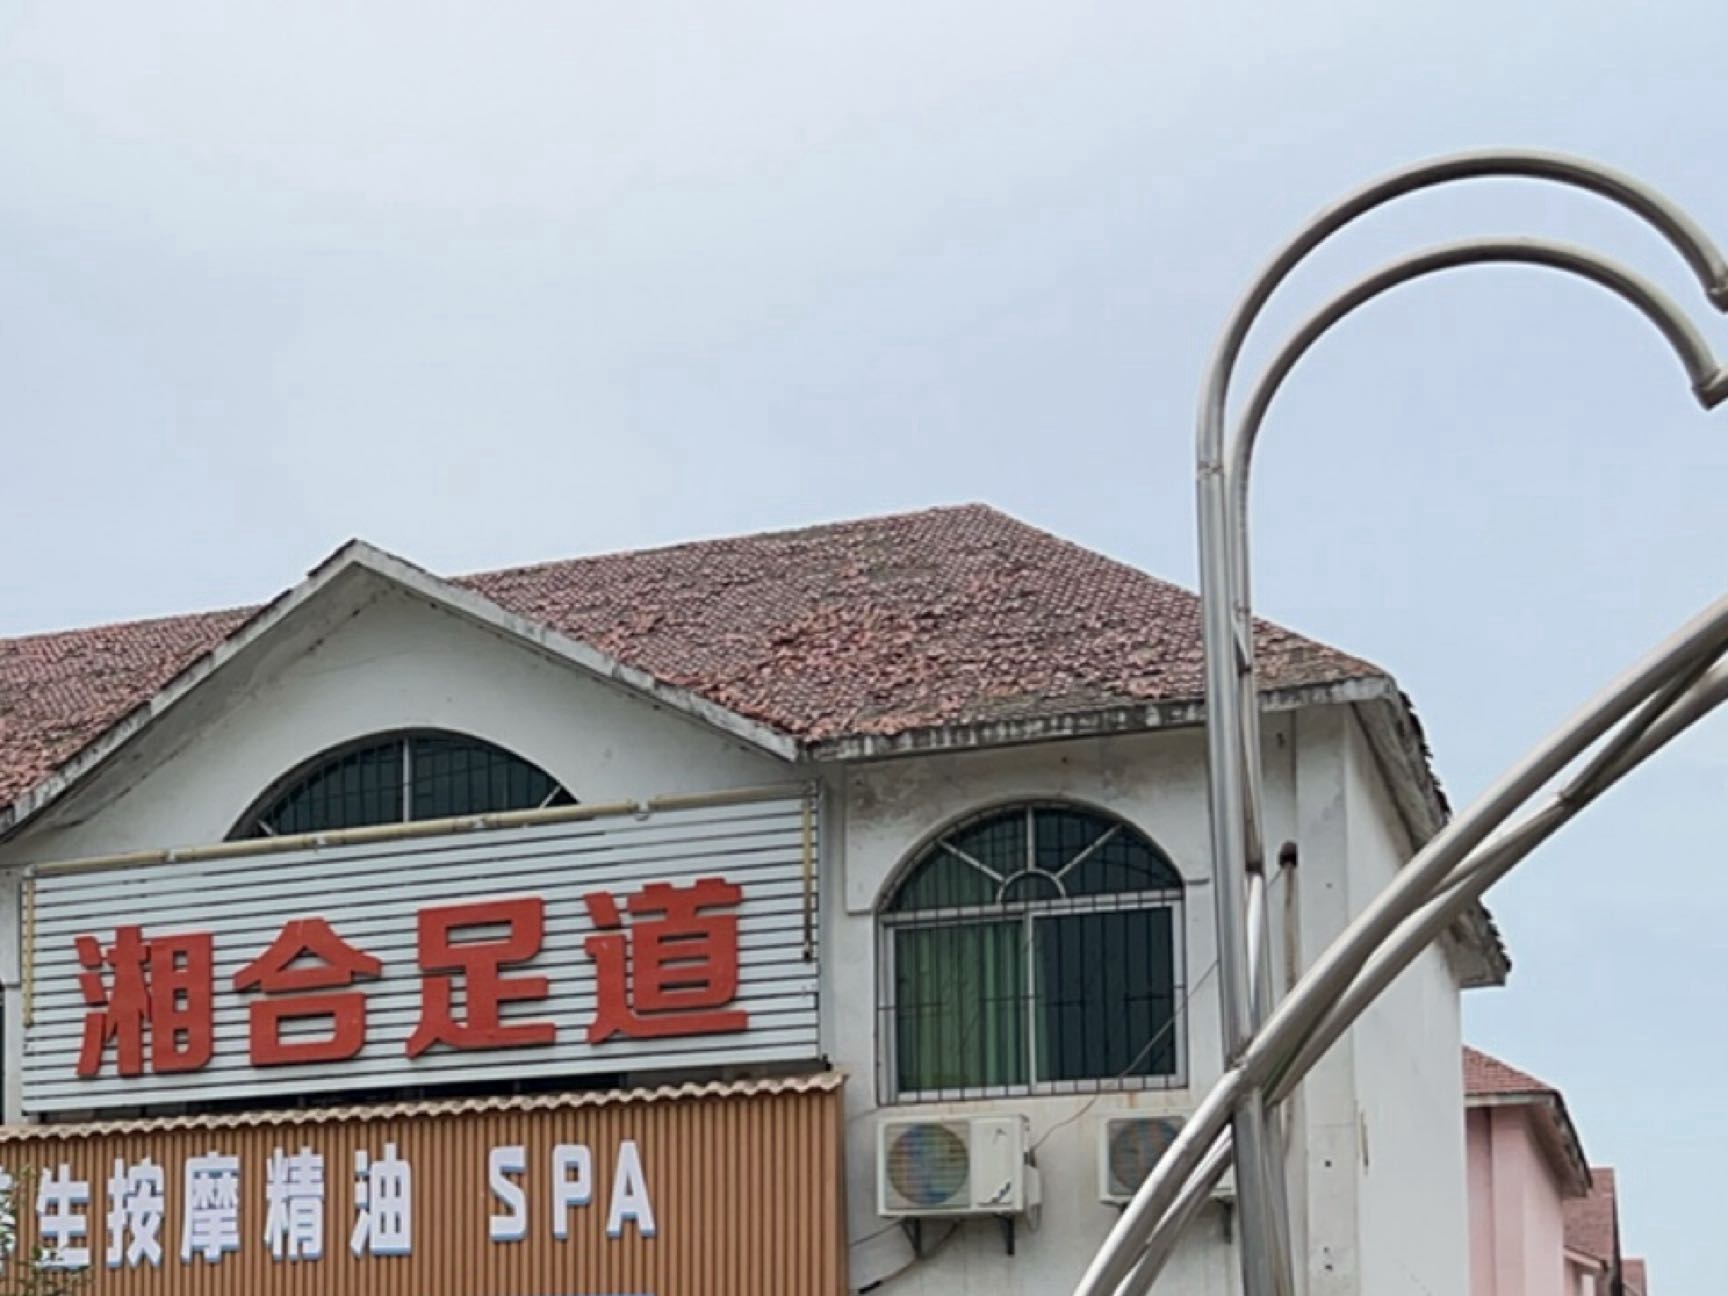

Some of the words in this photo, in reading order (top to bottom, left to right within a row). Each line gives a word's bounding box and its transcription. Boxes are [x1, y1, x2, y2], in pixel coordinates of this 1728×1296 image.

[75, 876, 749, 1078] 湘合足道
[488, 1140, 656, 1242] SPA
